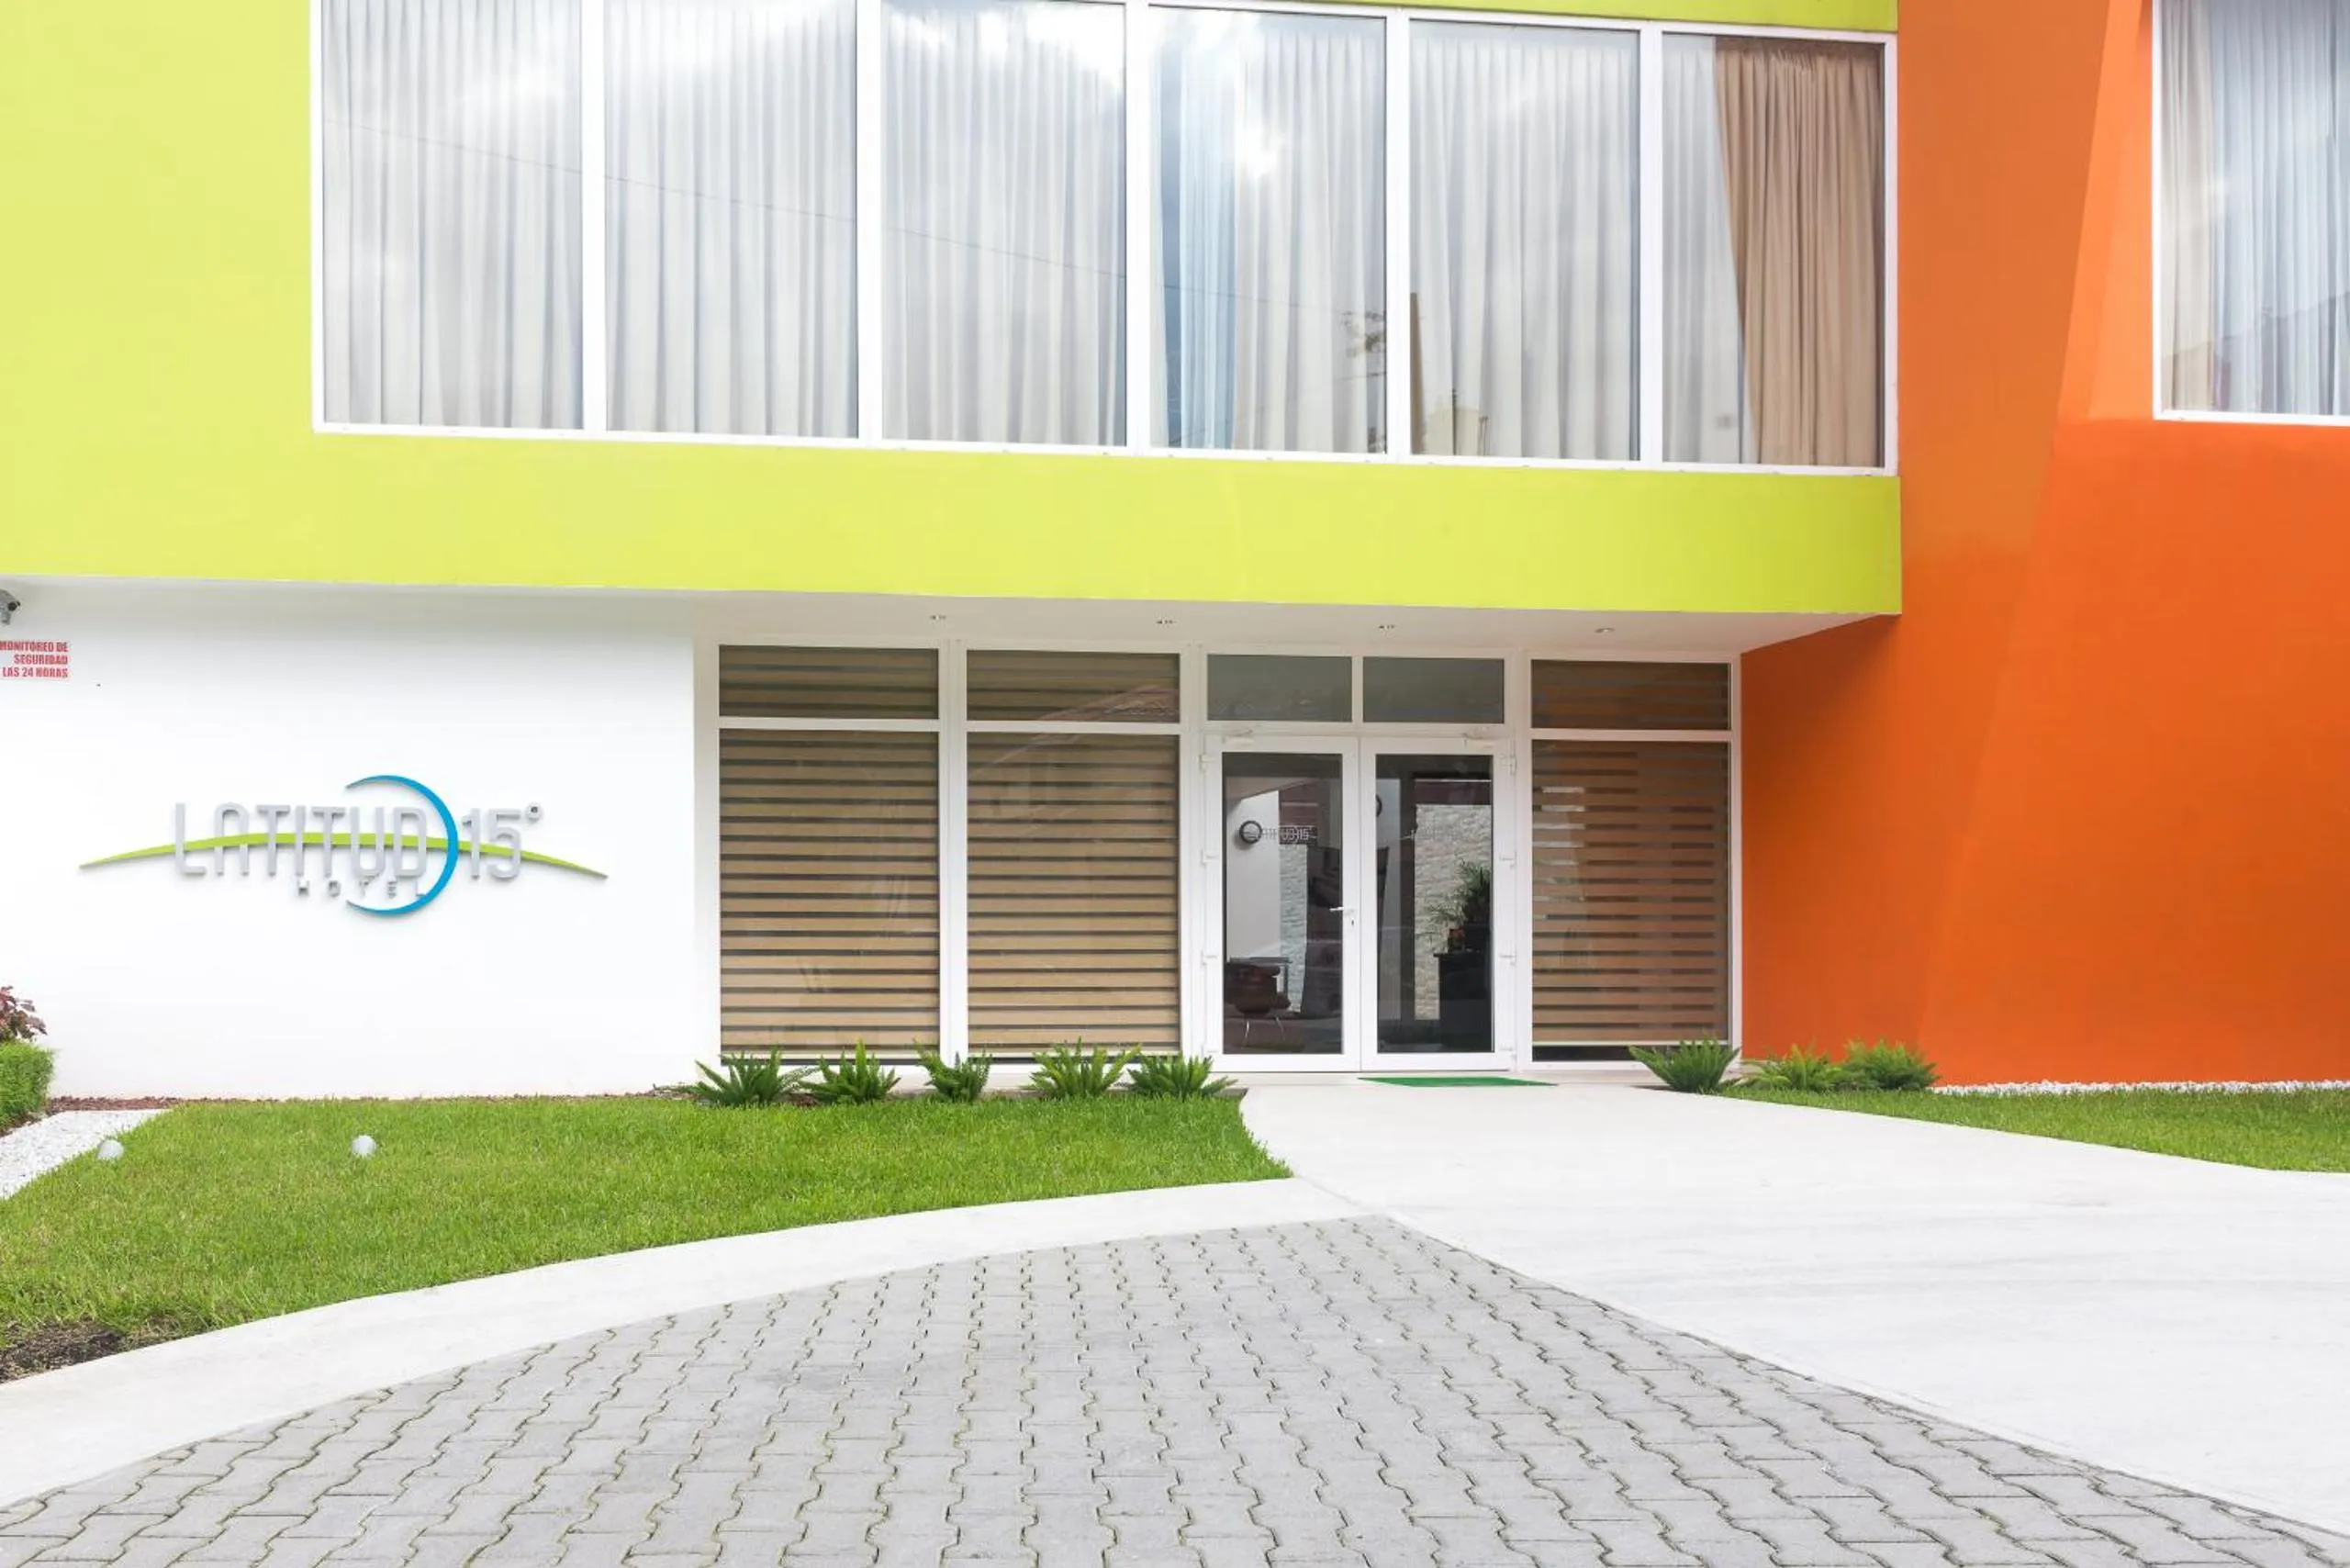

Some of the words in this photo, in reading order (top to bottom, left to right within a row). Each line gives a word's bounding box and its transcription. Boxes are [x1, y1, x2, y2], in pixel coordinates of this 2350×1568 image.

[56, 643, 68, 653] DE
[14, 654, 68, 665] SEGURIDAD
[2, 666, 19, 678] LAS
[21, 667, 34, 678] 24
[35, 667, 68, 678] HORAS
[174, 802, 428, 879] LATITUD
[296, 879, 428, 899] HOTEL
